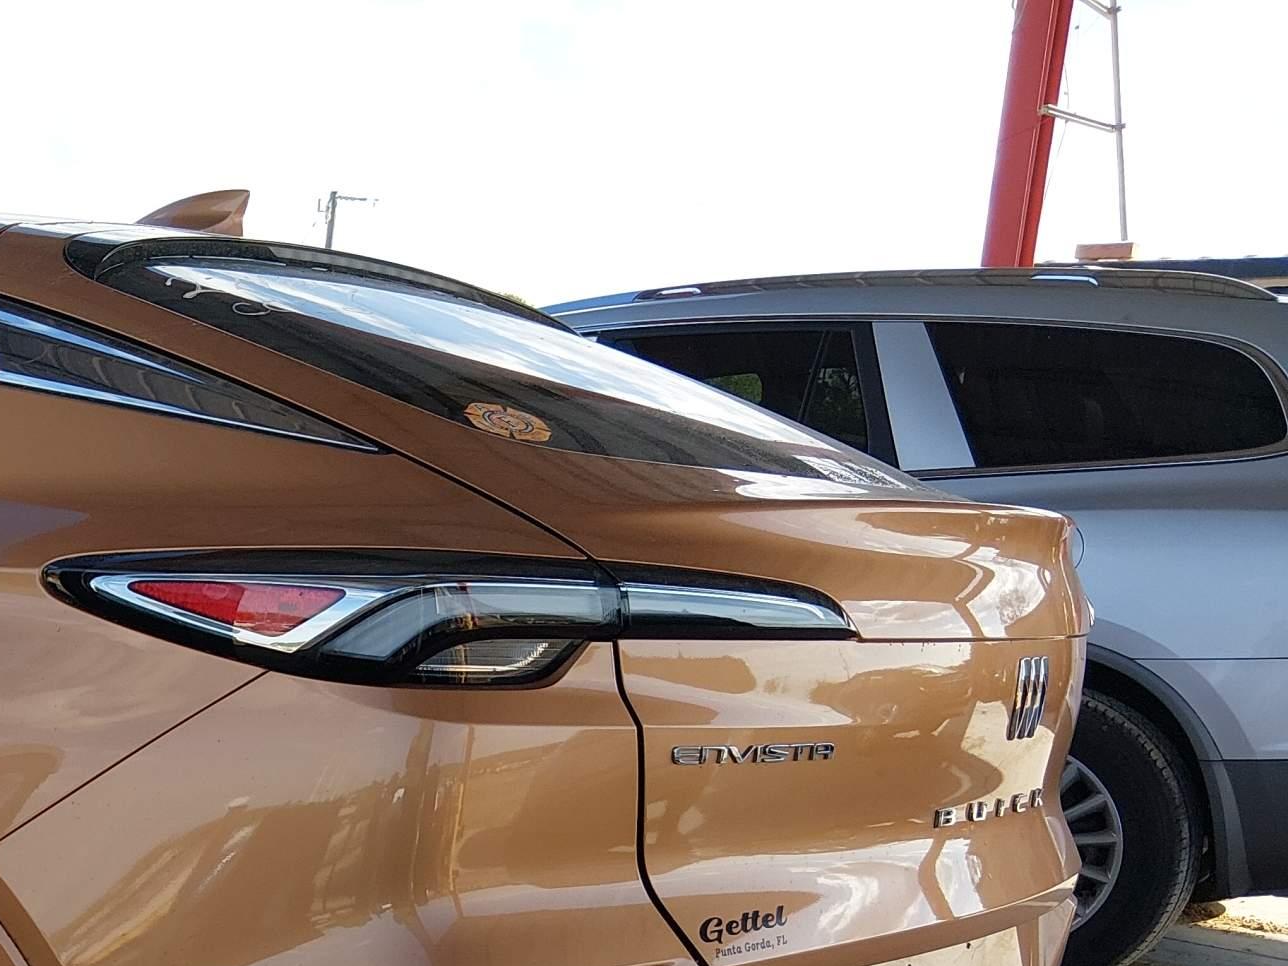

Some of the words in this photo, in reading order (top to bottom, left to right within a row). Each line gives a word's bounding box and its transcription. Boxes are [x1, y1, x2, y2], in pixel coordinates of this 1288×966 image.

[671, 742, 835, 765] ENVISTA
[933, 788, 1044, 828] BUICK
[699, 905, 788, 944] Gettel
[715, 946, 743, 958] Punta
[744, 938, 775, 952] Gorda,
[776, 934, 789, 946] FL
